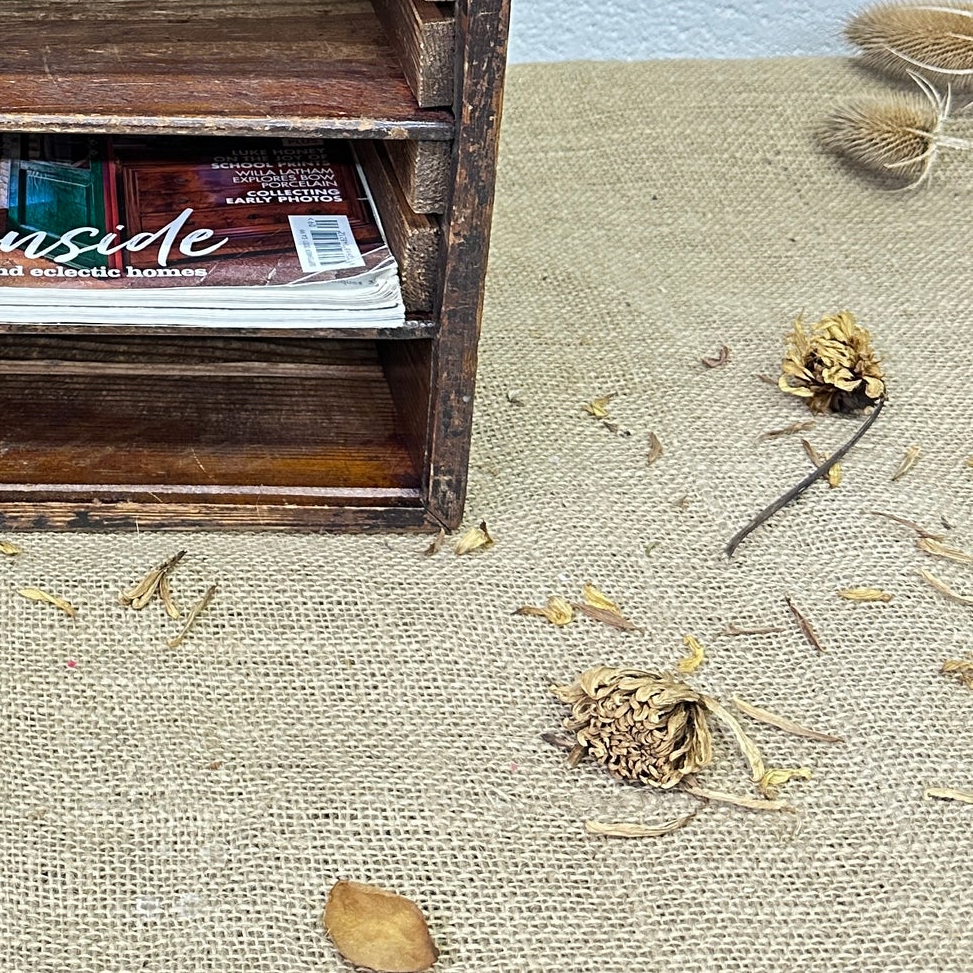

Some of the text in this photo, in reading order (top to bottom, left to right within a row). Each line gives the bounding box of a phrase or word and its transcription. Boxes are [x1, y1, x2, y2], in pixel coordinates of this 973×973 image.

[211, 160, 331, 170] SCHOOL PRINTS
[235, 168, 334, 177] WILLA LATHAM
[233, 173, 335, 184] EXPLORES BOW
[261, 180, 338, 189] PORCELAIN
[247, 189, 341, 198] COLLECTING
[226, 195, 343, 205] EARLY PHOTOS
[29, 265, 122, 278] eclectic
[125, 266, 207, 278] homes
